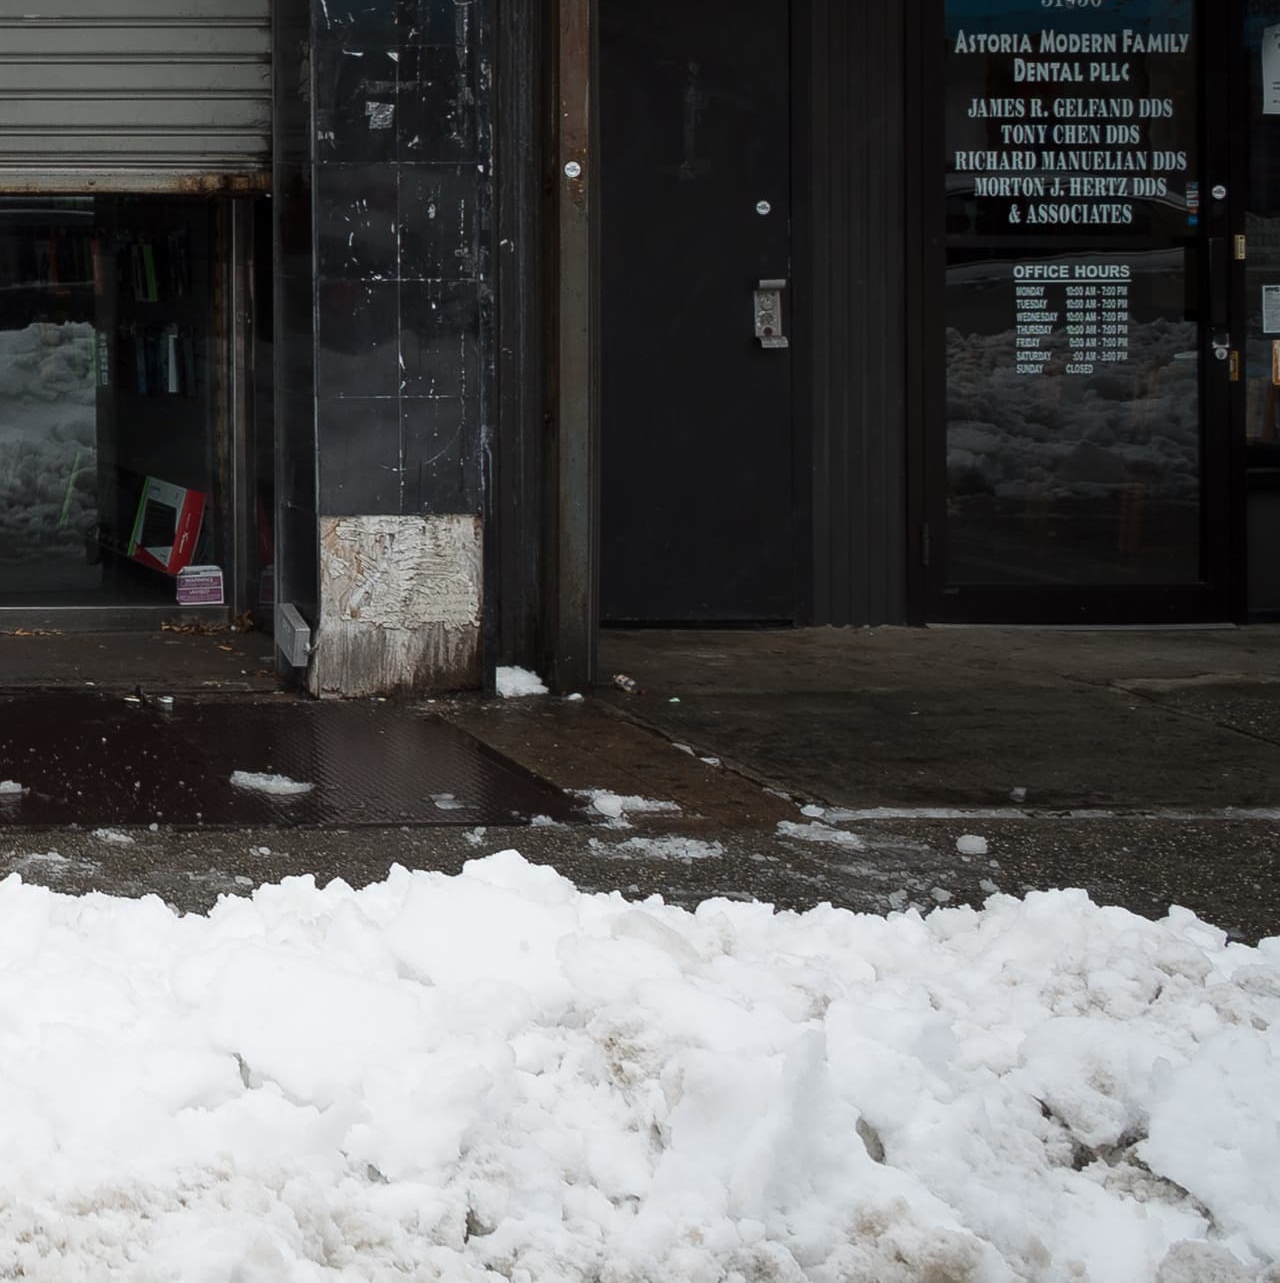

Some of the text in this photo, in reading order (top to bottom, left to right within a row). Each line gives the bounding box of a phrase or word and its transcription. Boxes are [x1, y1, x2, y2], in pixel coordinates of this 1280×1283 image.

[1089, 61, 1131, 83] PLLC
[967, 98, 1174, 118] JAMES R. GELFAND DDS
[1000, 124, 1140, 145] TONY CHEN DDS
[954, 150, 1188, 171] RICHARD MANUELIAN DDS
[974, 177, 1168, 198] MORTON J. HERTZ DDS
[1008, 203, 1133, 225] & ASSOCIATES
[1013, 265, 1131, 278] OFFICE HOURS
[1016, 286, 1045, 296] MONDAY
[1016, 299, 1048, 309] TUESDAY
[1016, 312, 1058, 322] WEDNESDAY
[1016, 325, 1053, 335] THURSDAY
[1016, 338, 1040, 348] FRIDAY
[1016, 351, 1052, 361] SATURDAY
[1016, 364, 1094, 374] SUNDAY CLOSED
